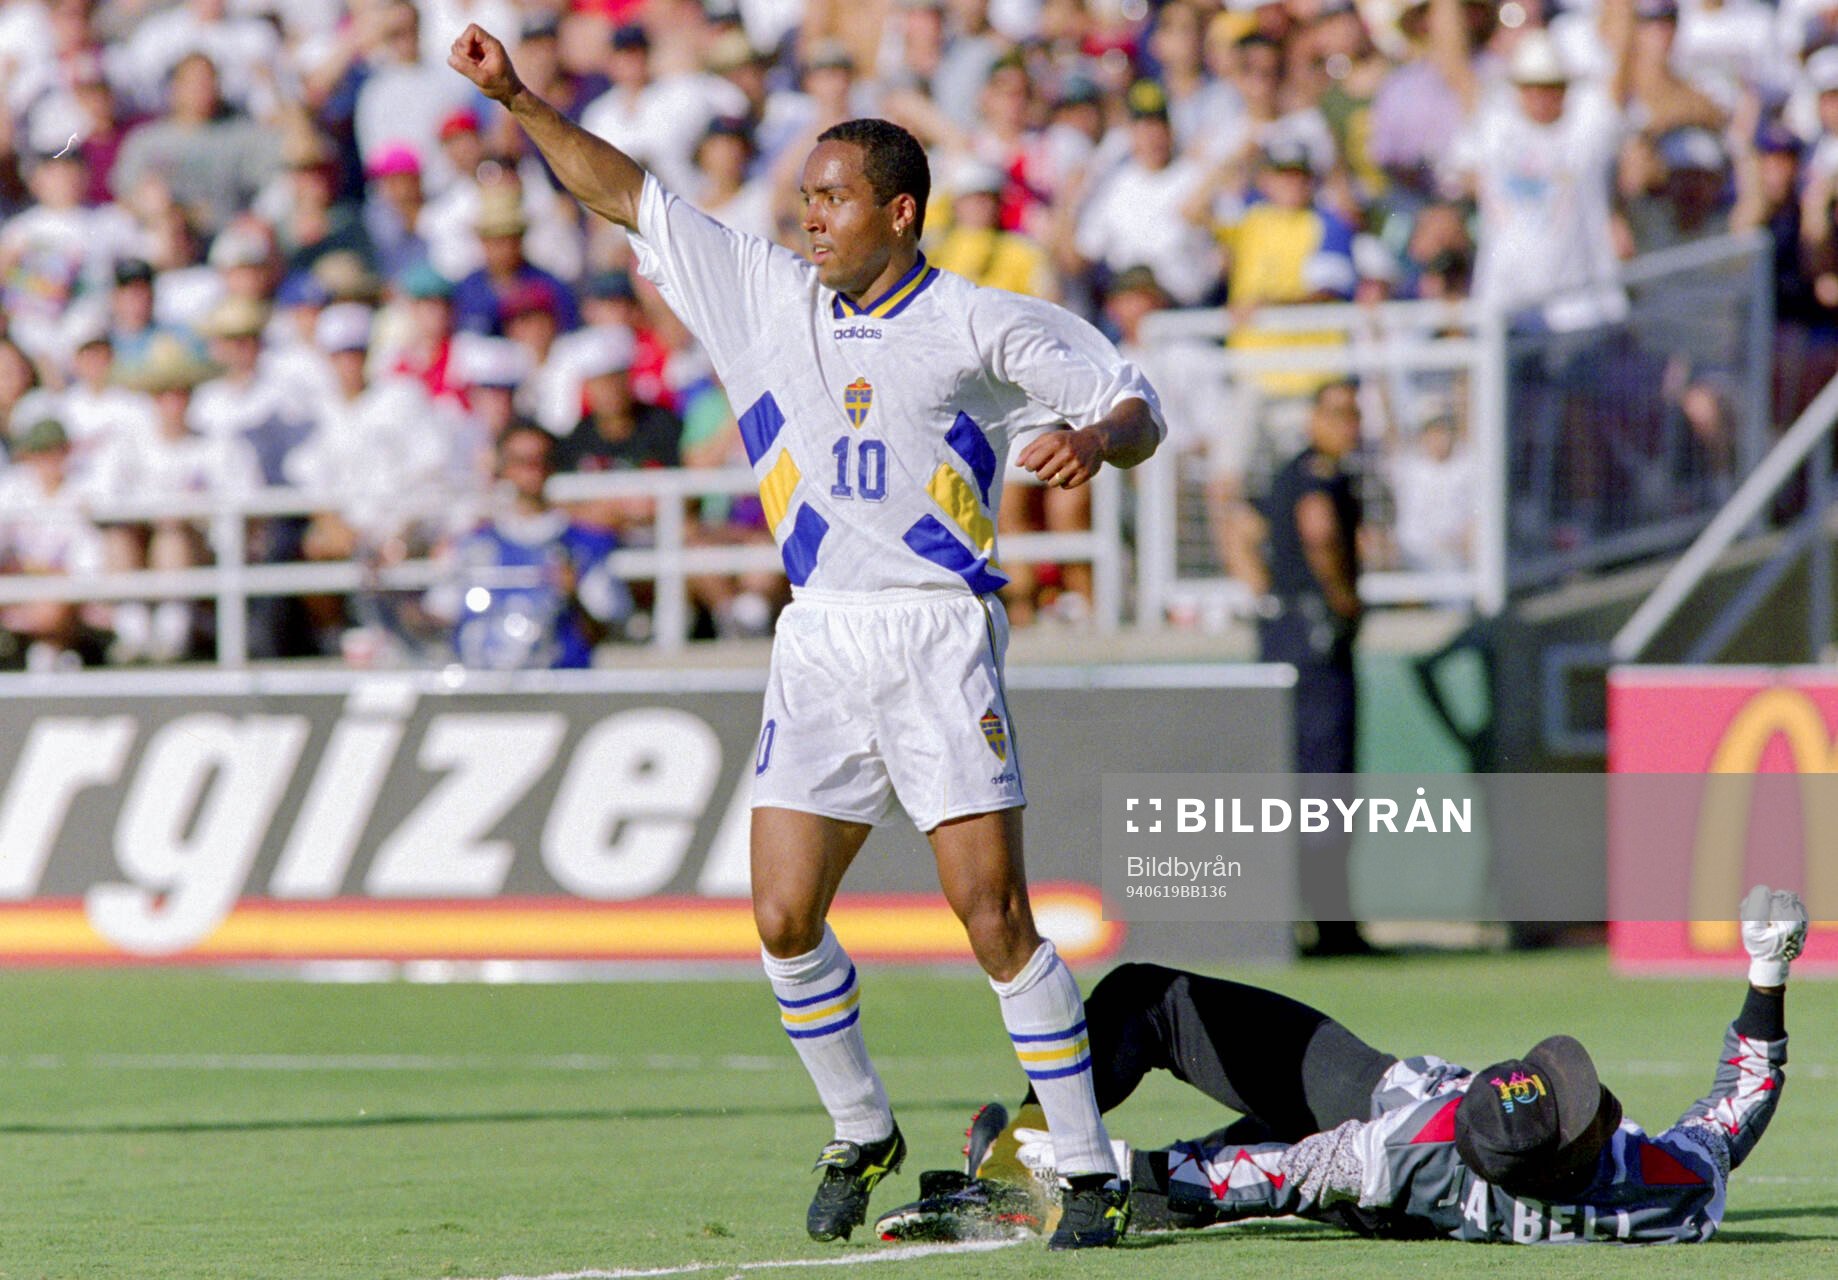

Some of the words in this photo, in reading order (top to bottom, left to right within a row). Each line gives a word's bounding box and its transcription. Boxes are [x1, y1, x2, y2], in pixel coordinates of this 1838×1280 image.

[834, 325, 882, 340] adidas
[831, 435, 889, 503] 10
[0, 676, 757, 955] rgize
